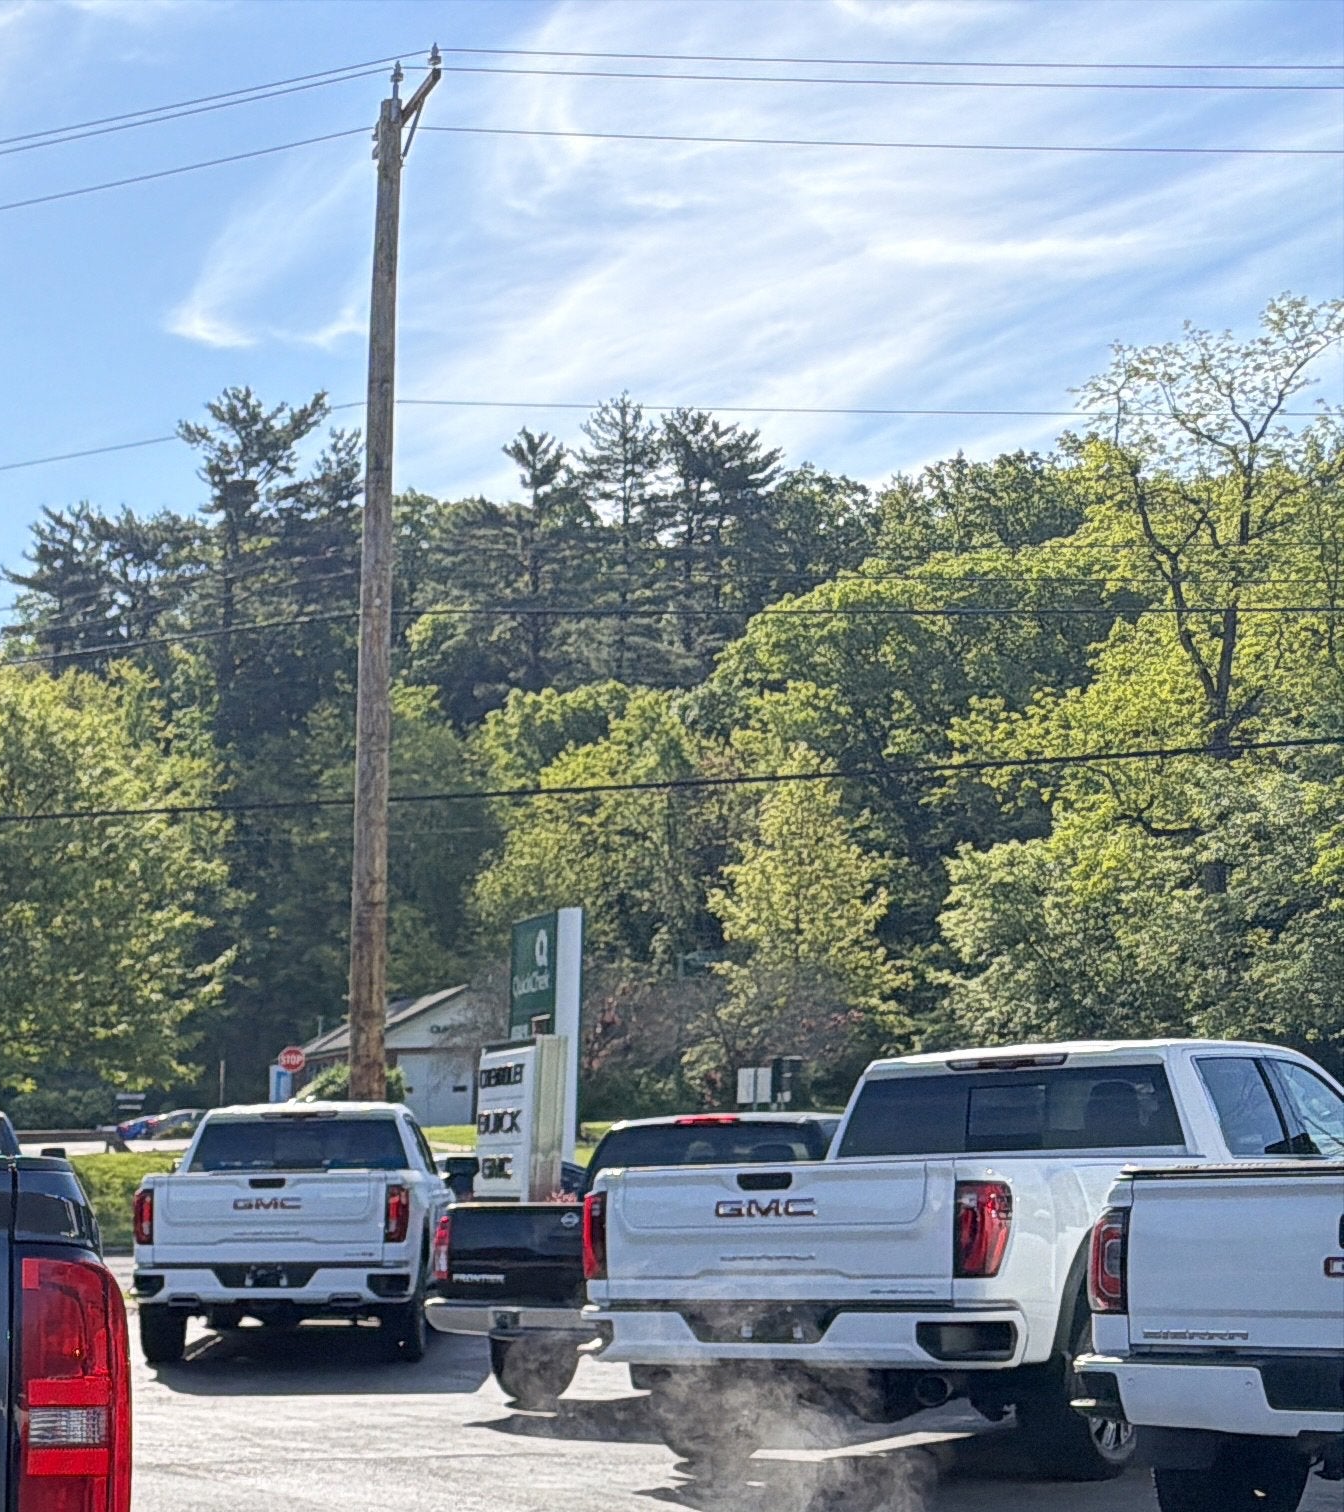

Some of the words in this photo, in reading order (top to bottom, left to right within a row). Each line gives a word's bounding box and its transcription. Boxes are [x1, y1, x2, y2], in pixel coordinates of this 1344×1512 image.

[478, 1109, 523, 1135] BUICK
[481, 1156, 513, 1180] GMC
[232, 1197, 303, 1211] GMC
[714, 1197, 819, 1218] GMC
[1143, 1328, 1250, 1341] SIERRA
